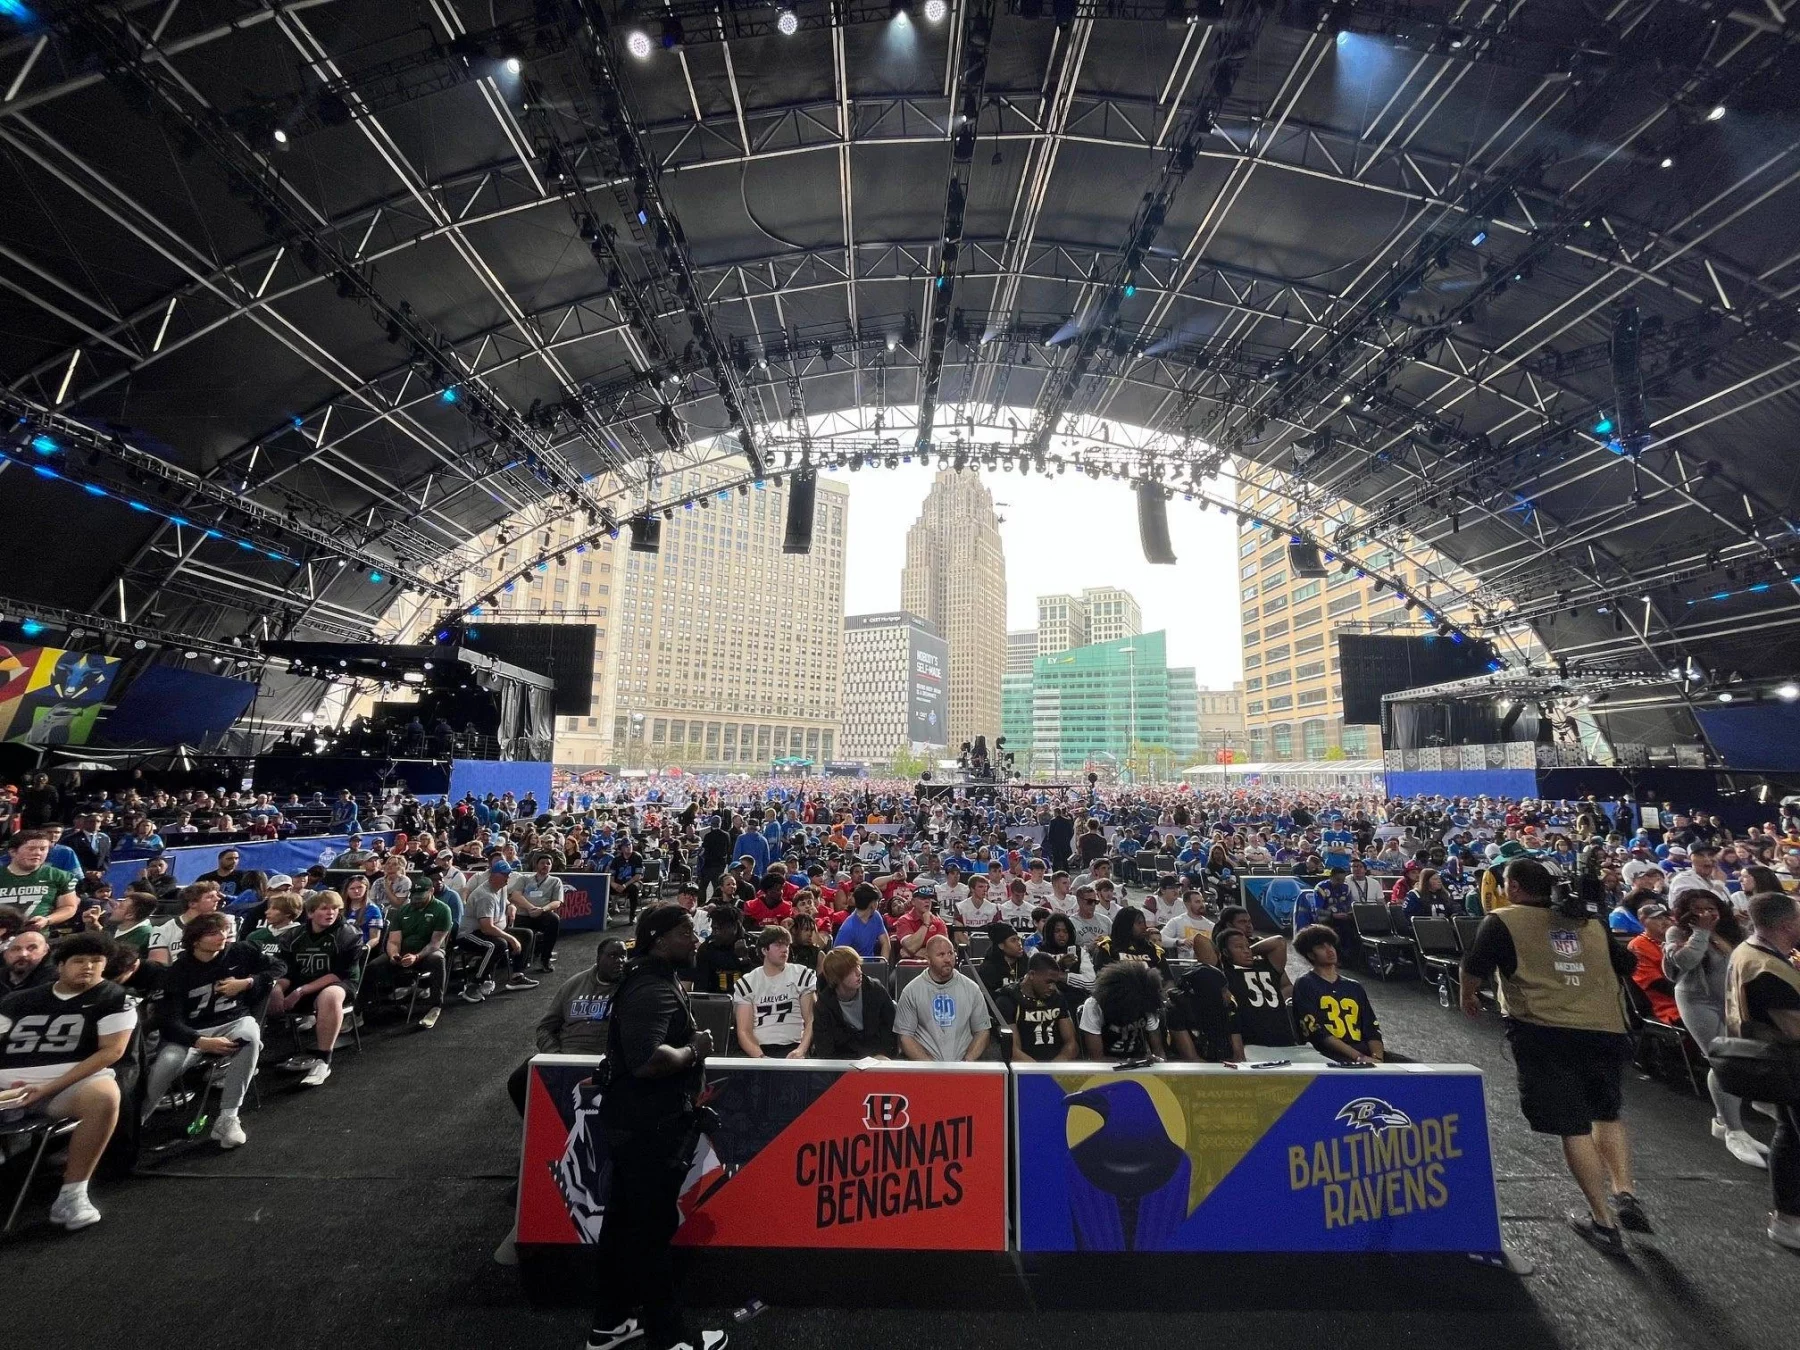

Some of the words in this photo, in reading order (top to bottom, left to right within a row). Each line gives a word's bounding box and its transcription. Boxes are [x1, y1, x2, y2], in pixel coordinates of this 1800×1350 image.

[1047, 657, 1058, 665] EY
[0, 885, 49, 897] RAGONS
[558, 902, 592, 919] ONCOS
[1554, 940, 1579, 954] NFL
[1118, 952, 1152, 962] KING
[1554, 961, 1585, 973] MEDIA
[1243, 971, 1280, 1009] 55
[1564, 974, 1580, 987] 70
[759, 993, 799, 1004] LAKEVIEW
[569, 1000, 614, 1019] LIO
[756, 1001, 793, 1027] 77
[1024, 1007, 1061, 1022] KING
[1320, 995, 1362, 1042] 32
[6, 1013, 86, 1055] 59
[1033, 1022, 1056, 1046] 11
[796, 1115, 973, 1187] CINCINNATI
[1288, 1113, 1463, 1191] BALTIMORE
[816, 1161, 964, 1229] BENGALS
[1323, 1162, 1449, 1230] RAVENS
